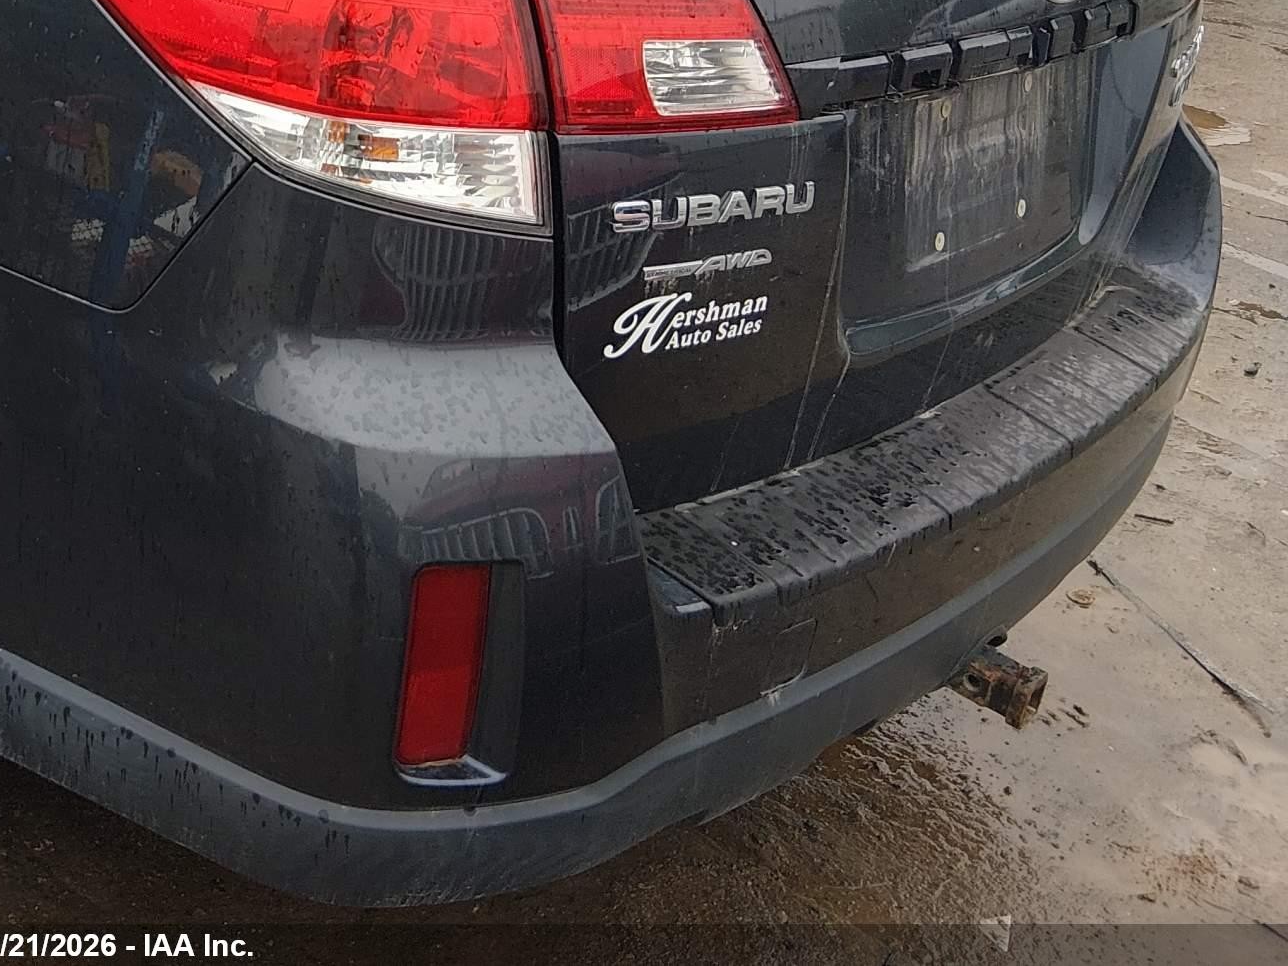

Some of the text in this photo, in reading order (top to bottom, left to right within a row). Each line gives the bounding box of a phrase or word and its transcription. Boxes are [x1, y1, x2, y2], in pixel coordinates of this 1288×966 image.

[610, 181, 816, 233] SUBARU
[694, 248, 772, 275] AWD
[603, 291, 768, 359] Hershman
[665, 317, 763, 350] Auto Sales
